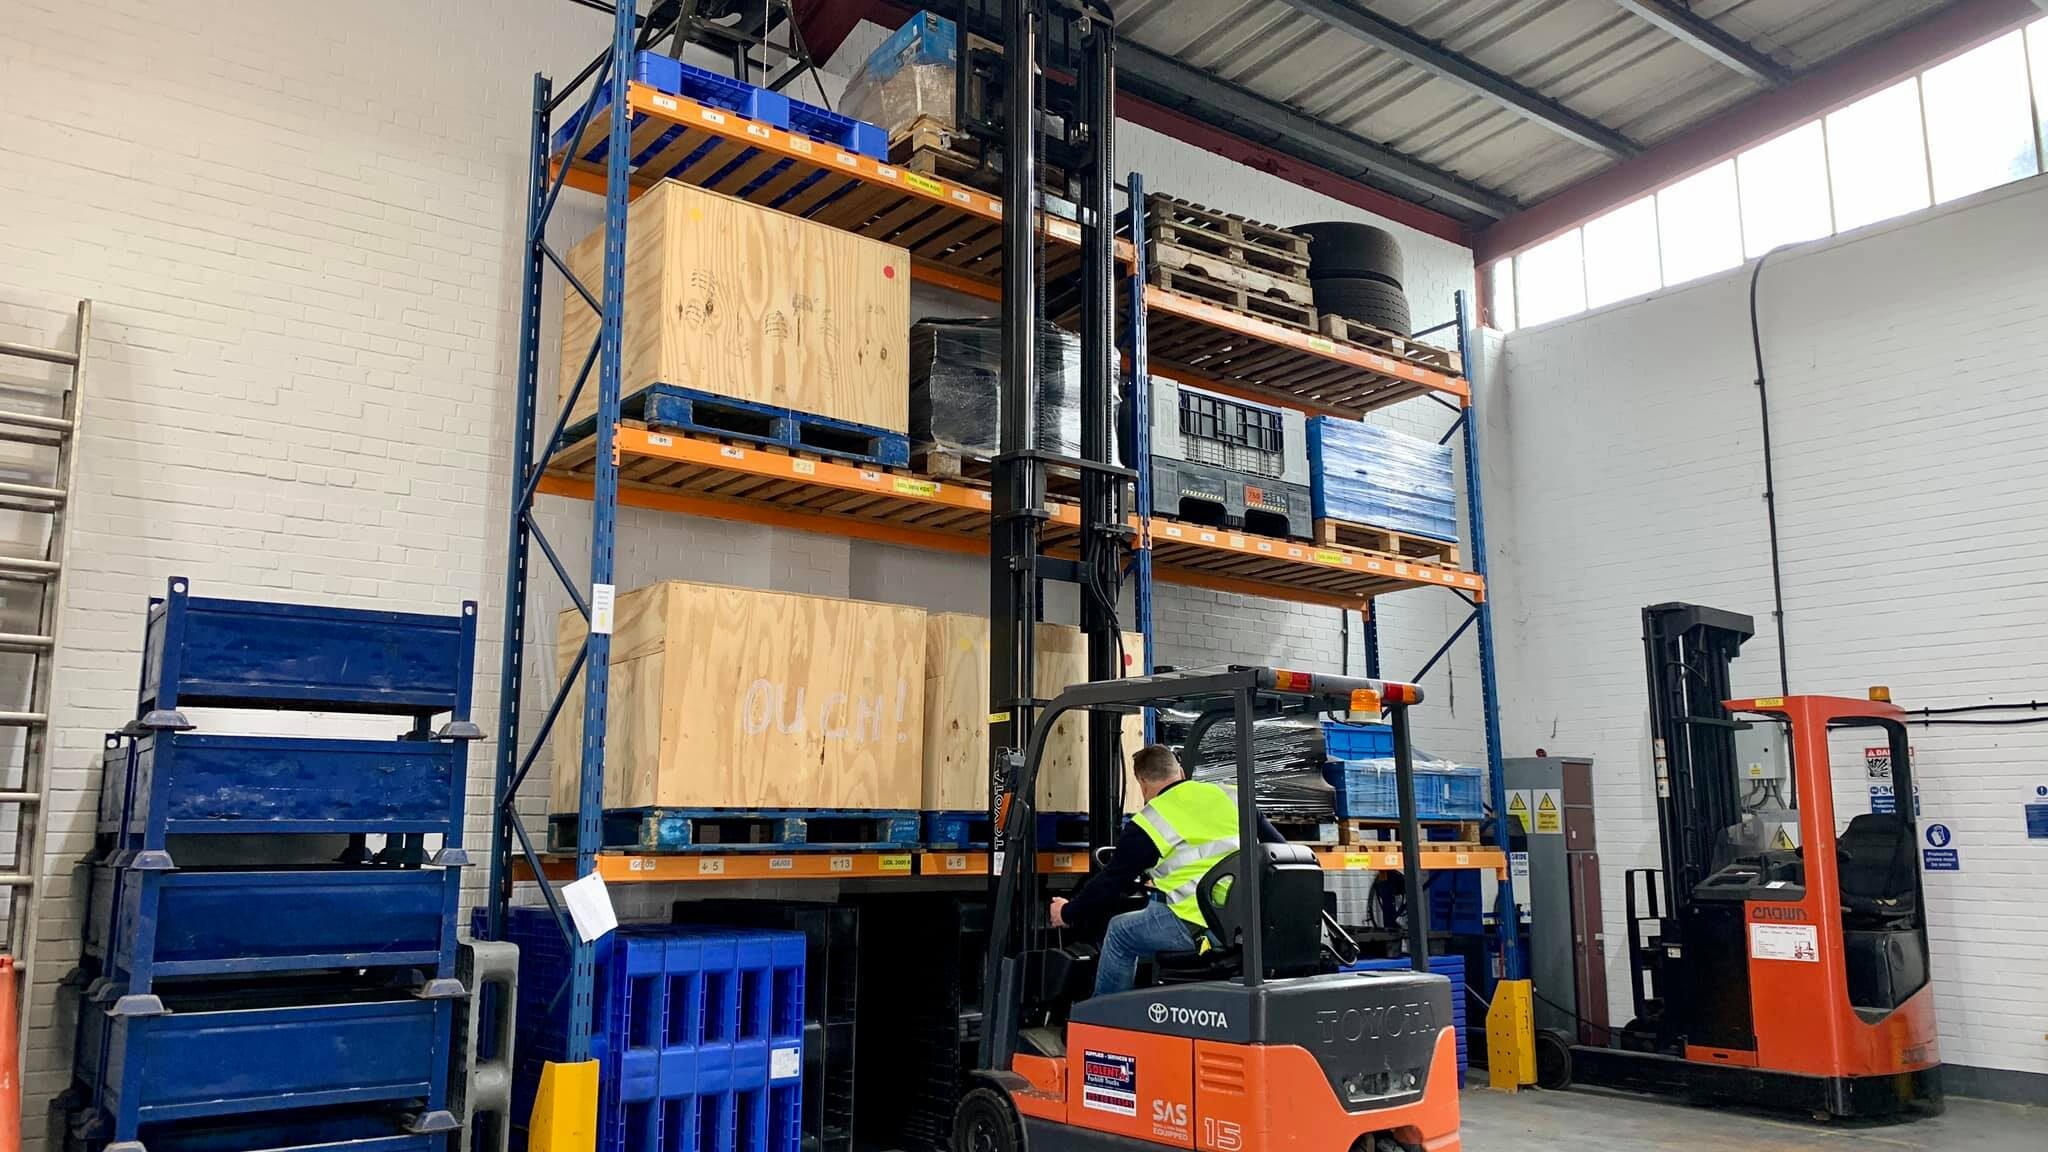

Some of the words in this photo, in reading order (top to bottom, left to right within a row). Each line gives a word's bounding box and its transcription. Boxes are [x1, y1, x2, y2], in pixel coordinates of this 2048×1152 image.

[743, 678, 907, 743] OUCH!
[712, 860, 719, 871] 5
[840, 858, 850, 869] 13
[1752, 906, 1808, 920] CROWN
[1170, 1007, 1228, 1029] TOYOTA
[1316, 1000, 1437, 1043] TOYOTA
[1087, 1063, 1120, 1080] SOLENT
[1152, 1099, 1187, 1126] SAS
[1152, 1126, 1188, 1141] EQUIPPED
[1204, 1116, 1243, 1152] 15
